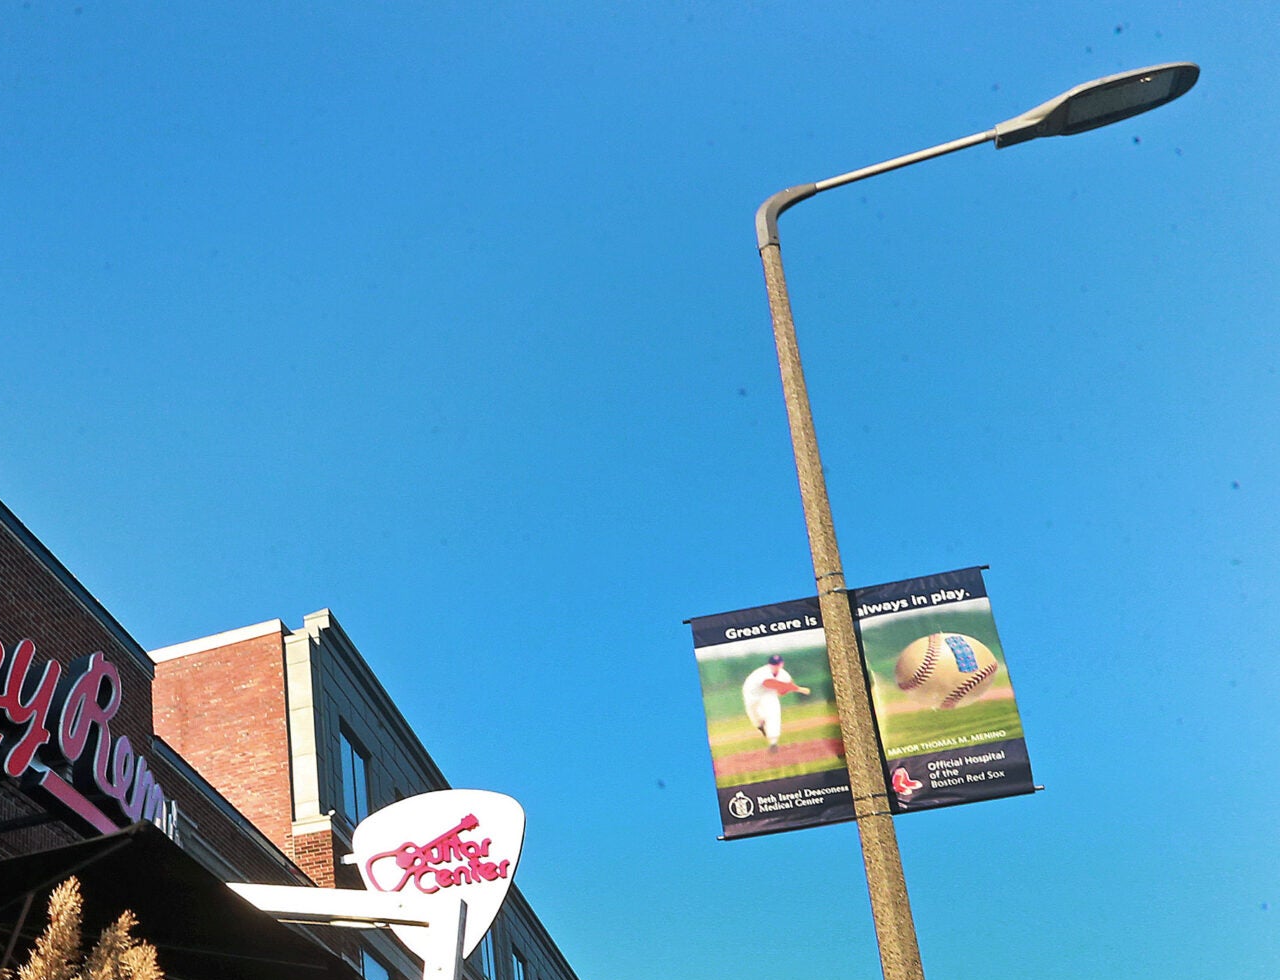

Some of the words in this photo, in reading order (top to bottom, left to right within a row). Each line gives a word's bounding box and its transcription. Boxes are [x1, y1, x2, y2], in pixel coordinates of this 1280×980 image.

[725, 623, 767, 640] Great
[770, 619, 802, 632] care
[805, 615, 818, 626] is
[911, 595, 928, 606] in
[931, 588, 970, 605] play.
[58, 652, 182, 848] Rem
[887, 746, 920, 756] MAYOR
[921, 738, 958, 750] THOMAS
[970, 730, 1007, 742] MENINO
[927, 758, 963, 771] Official
[964, 750, 1005, 765] Hospital
[929, 769, 940, 779] of
[942, 768, 959, 778] the
[931, 777, 964, 788] Boston
[966, 773, 985, 783] Red
[987, 770, 1005, 780] Sox
[759, 801, 793, 813] Medical
[794, 797, 824, 807] Center
[778, 789, 802, 802] Israel
[414, 859, 510, 894] Center
